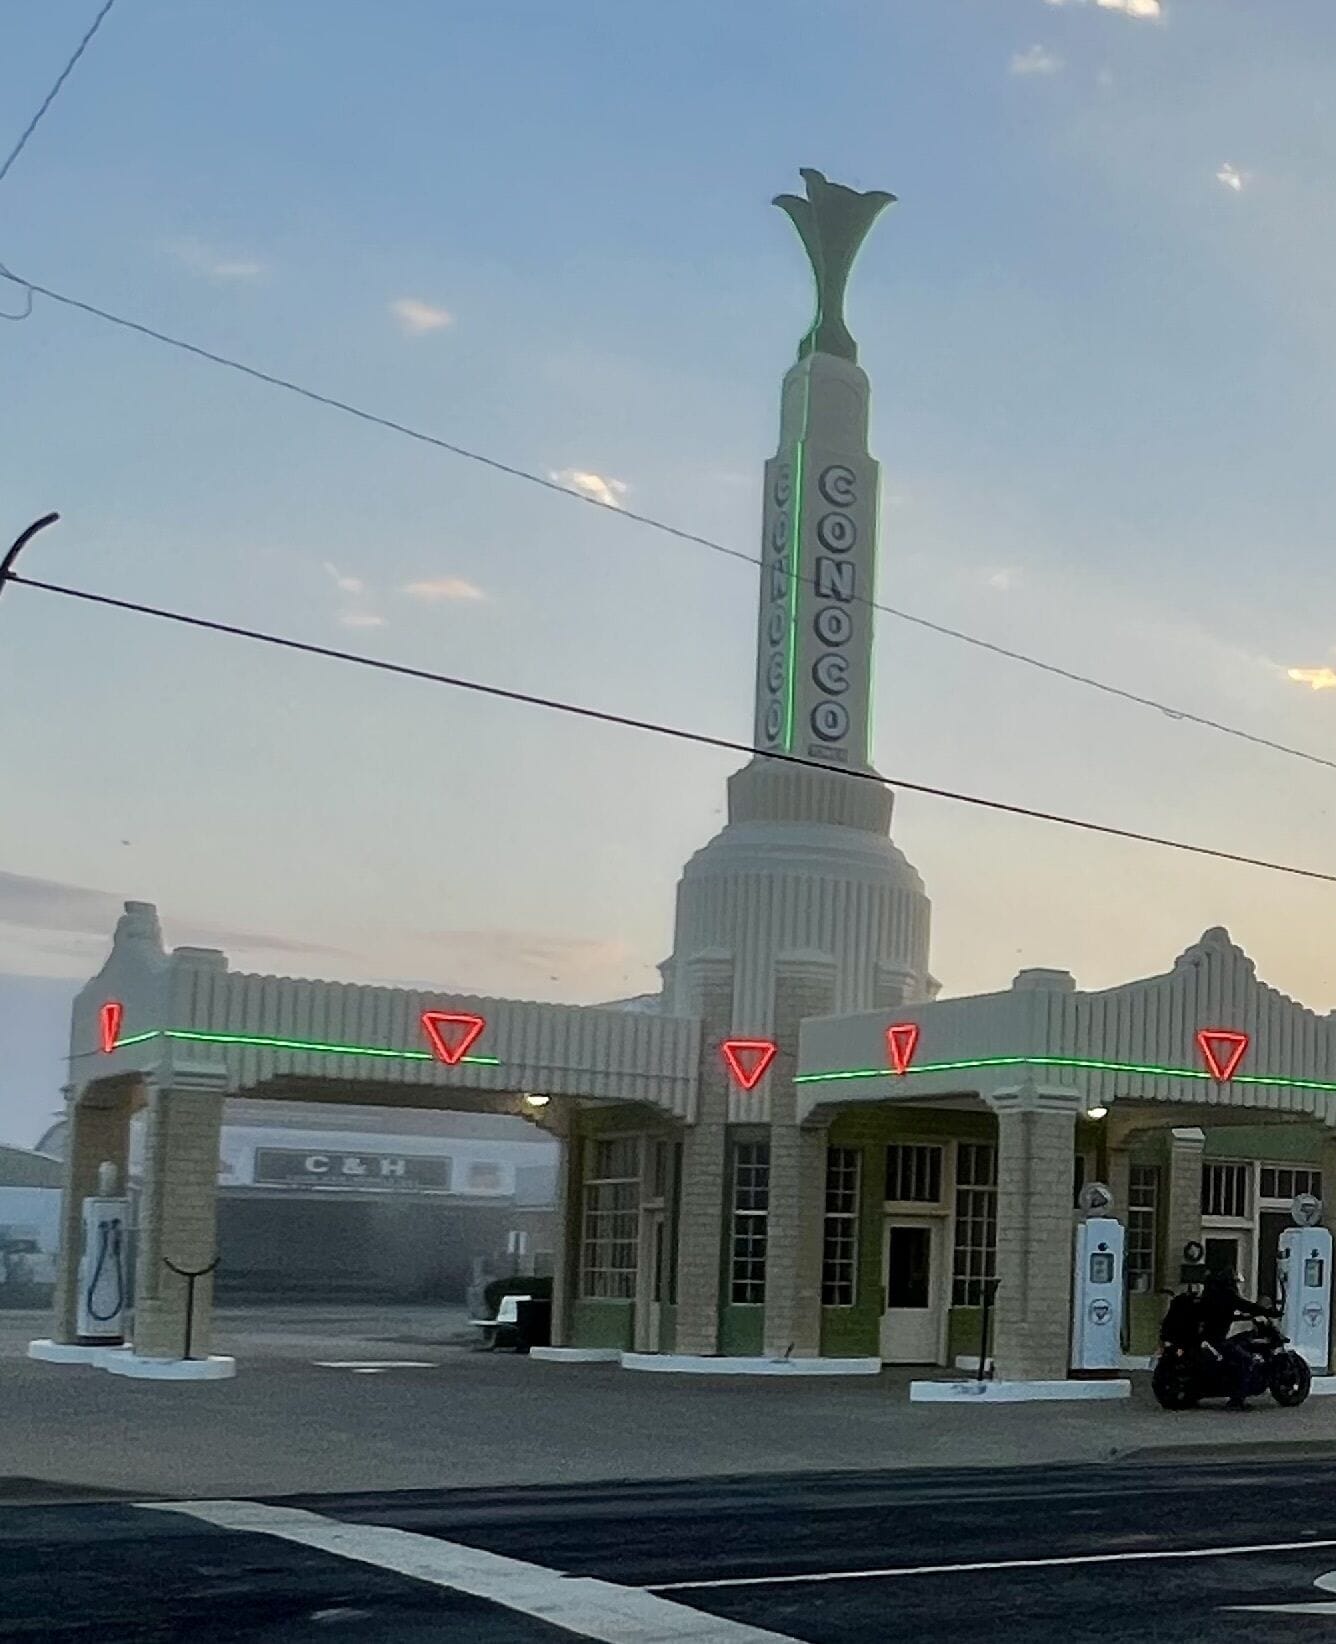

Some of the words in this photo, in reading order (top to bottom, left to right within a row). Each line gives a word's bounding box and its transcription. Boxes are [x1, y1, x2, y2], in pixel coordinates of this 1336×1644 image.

[810, 465, 857, 742] CONOCO
[305, 1156, 329, 1173] C
[342, 1158, 367, 1175] &
[381, 1159, 406, 1176] H
